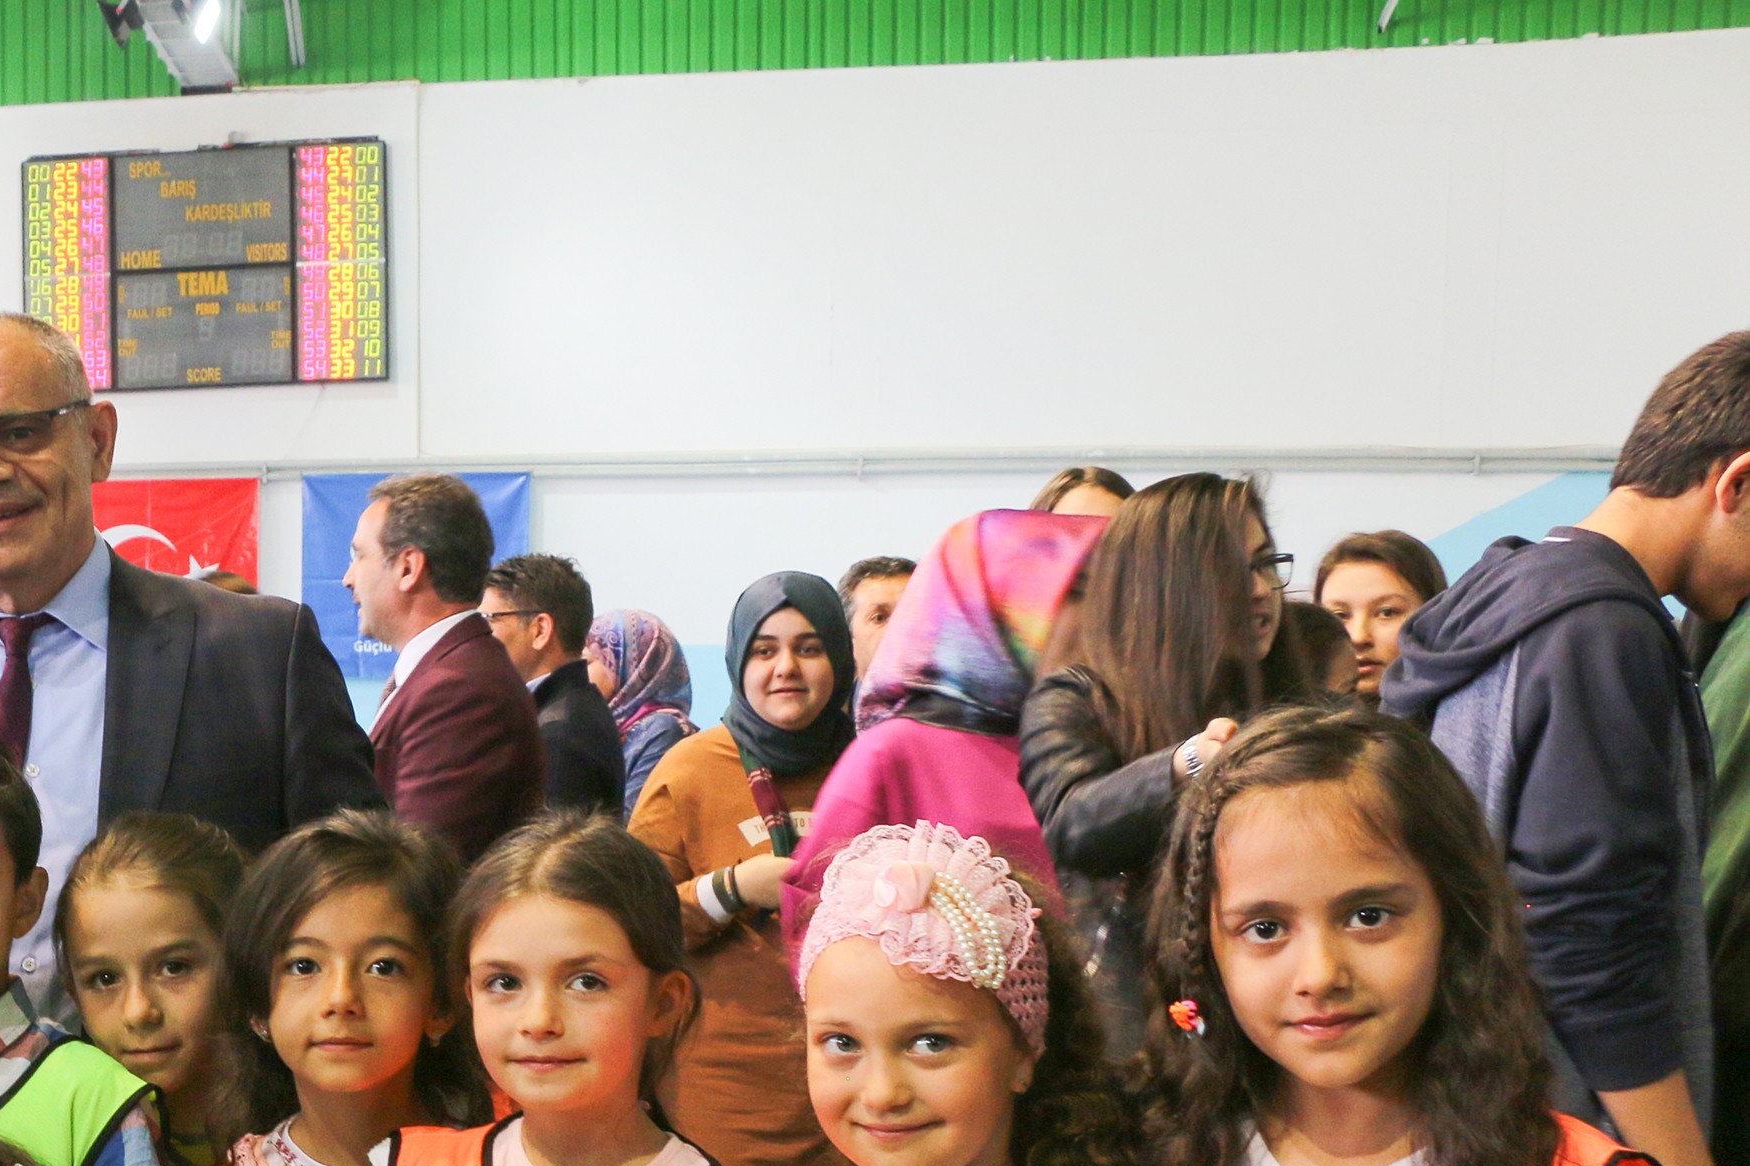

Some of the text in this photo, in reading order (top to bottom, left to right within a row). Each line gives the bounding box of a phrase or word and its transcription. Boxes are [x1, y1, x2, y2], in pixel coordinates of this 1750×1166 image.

[300, 146, 379, 165] 43 22 00
[28, 159, 103, 182] 00 22 43
[300, 166, 324, 184] 44
[356, 166, 379, 183] 01
[29, 180, 104, 202] 01 23 44
[160, 178, 196, 199] BARIŞ
[300, 184, 380, 204] 45 24 02
[29, 198, 104, 220] 02 24 45
[185, 199, 272, 223] KARDEŞLİKTİR
[300, 204, 380, 223] 46 25 03
[29, 217, 104, 240] 03 25 46
[301, 223, 380, 242] 47 26 04
[30, 236, 104, 258] 04 26 47
[246, 242, 288, 262] VISITORS
[302, 242, 380, 262] 48 27 05
[30, 255, 105, 277] 05 27 48
[120, 249, 162, 269] HOME
[302, 262, 380, 280] 49 28 06
[55, 276, 80, 295] 28
[83, 273, 105, 292] 49
[177, 270, 229, 297] TEMA
[303, 282, 326, 300] 50
[328, 280, 354, 300] 29
[357, 280, 381, 300] 07
[31, 297, 52, 314] 07
[56, 294, 80, 314] 29
[83, 293, 105, 312] 50
[127, 307, 149, 319] FAUL
[155, 306, 173, 318] SET
[236, 302, 258, 314] FAUL
[265, 300, 282, 312] SET
[304, 300, 381, 320] 51 30 08
[56, 314, 80, 332] 30
[84, 312, 106, 331] 51
[304, 320, 382, 339] 52 31 09
[84, 331, 106, 349] 52
[304, 338, 382, 358] 53 32 10
[84, 350, 106, 369] 53
[304, 360, 327, 378] 54
[330, 358, 356, 378] 33
[364, 359, 382, 376] 11
[186, 367, 222, 382] SCORE
